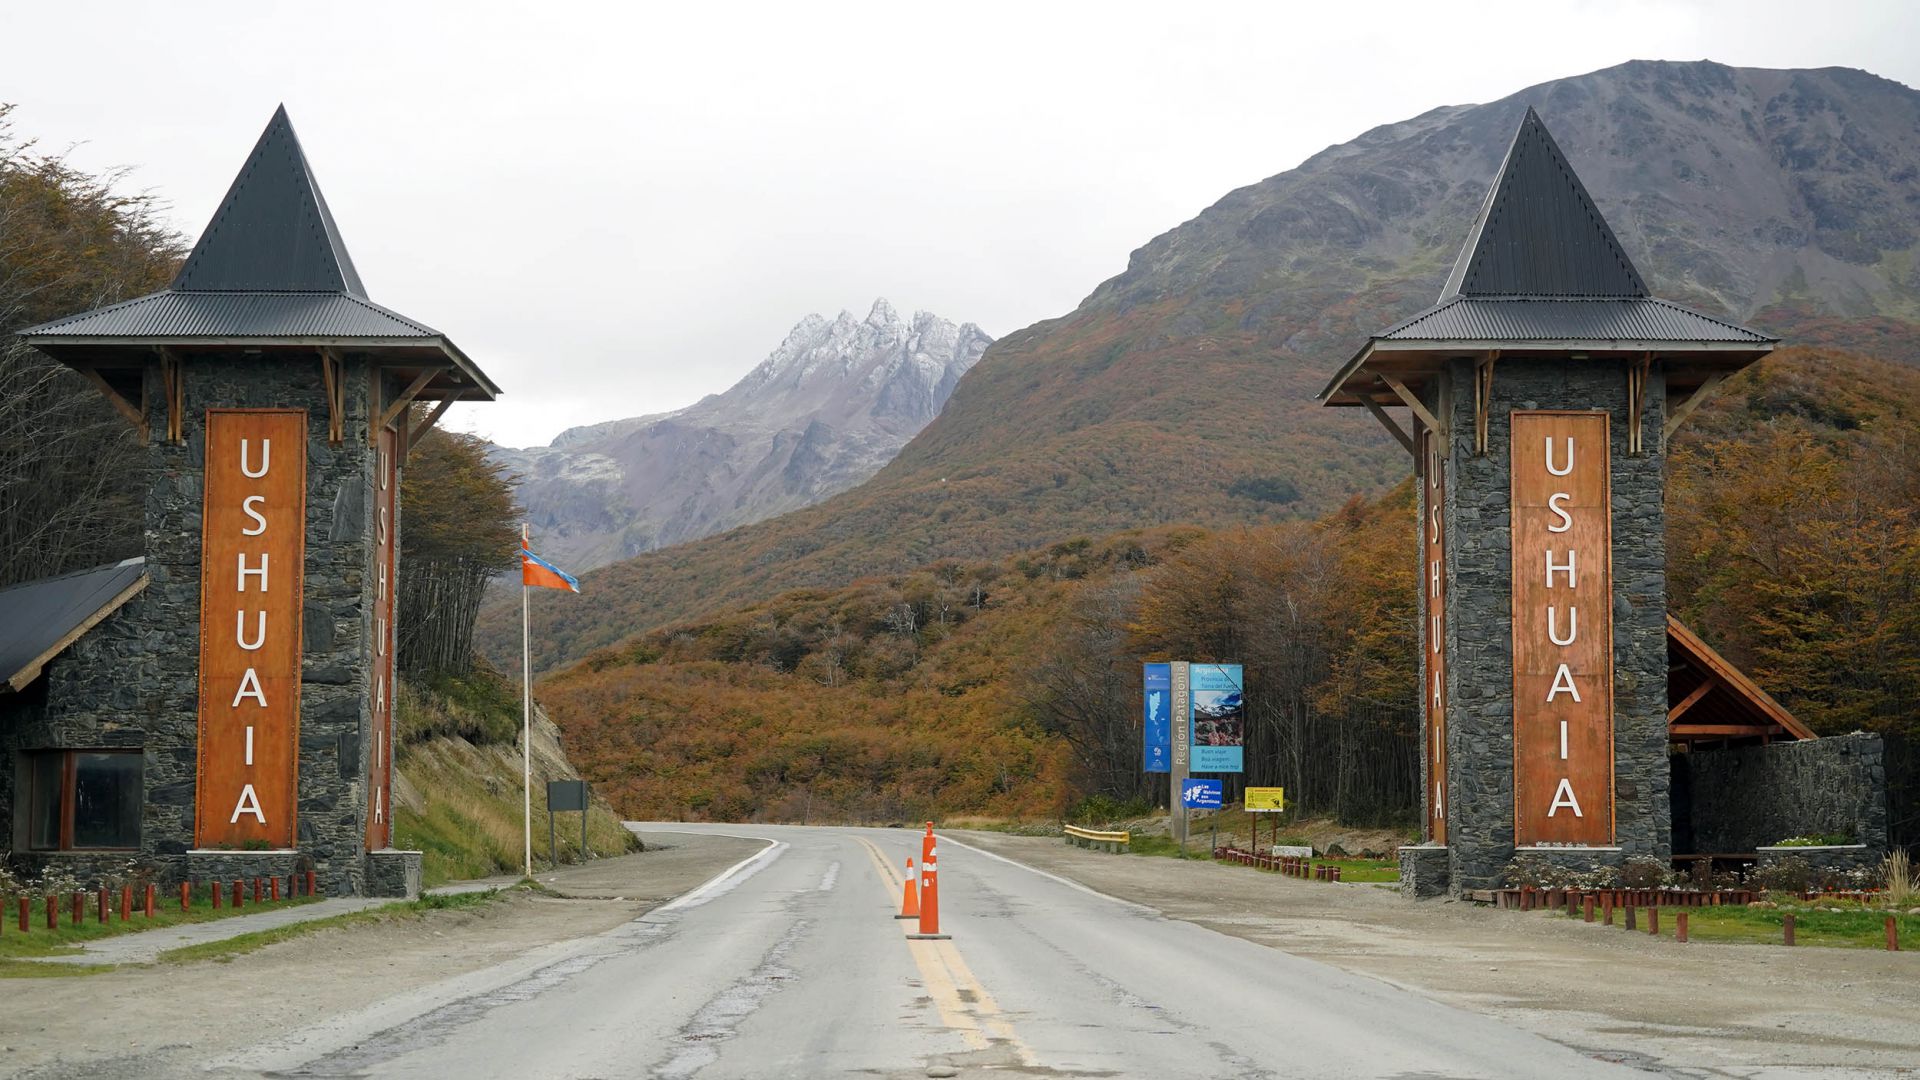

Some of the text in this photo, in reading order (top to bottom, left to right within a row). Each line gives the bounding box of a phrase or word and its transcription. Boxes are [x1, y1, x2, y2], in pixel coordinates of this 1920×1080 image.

[230, 438, 270, 824] USHUAIA
[374, 452, 388, 824] USHUAIA
[1176, 666, 1188, 765] Región Patagonia
[1430, 451, 1443, 819] USHUAIA
[1545, 436, 1583, 818] USHUAIA
